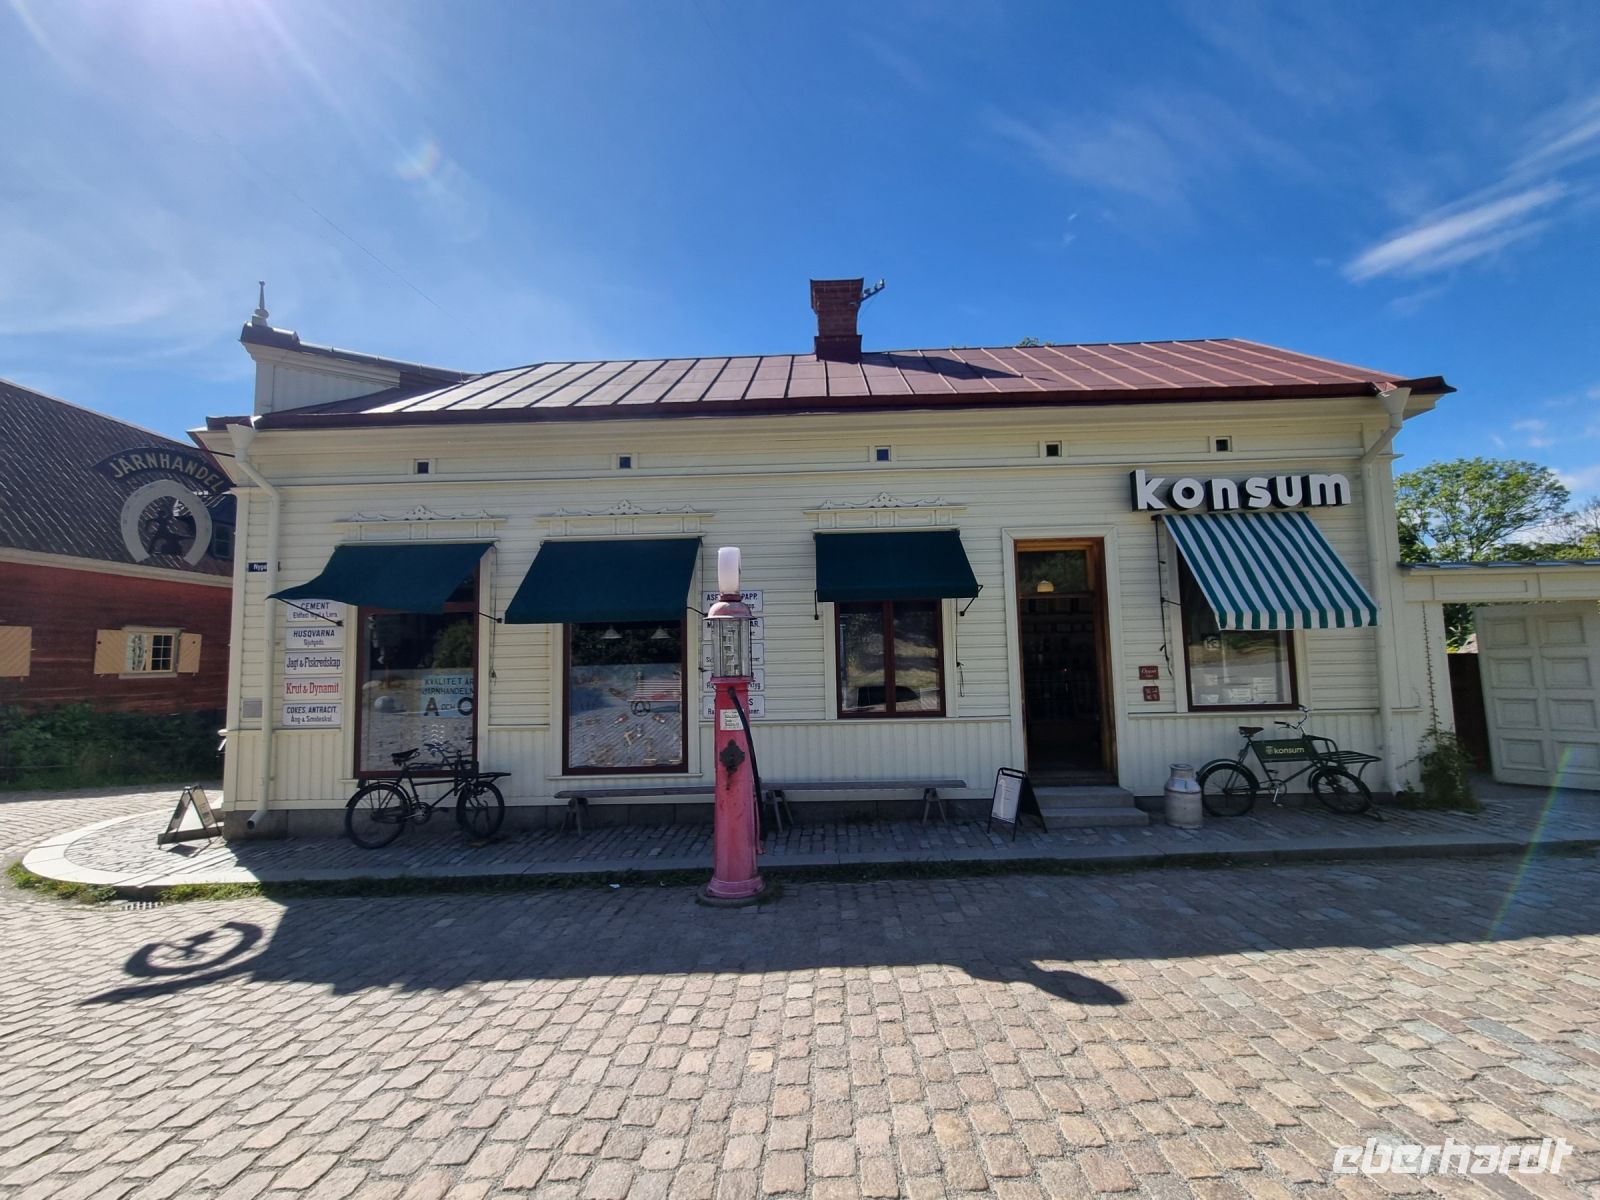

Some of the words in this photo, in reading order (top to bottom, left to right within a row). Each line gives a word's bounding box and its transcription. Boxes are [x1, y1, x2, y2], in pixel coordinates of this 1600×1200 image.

[110, 453, 224, 492] JÄRNHANDEL
[1131, 469, 1352, 511] konsum
[301, 602, 330, 610] CEMENT
[293, 629, 335, 638] HUSQVARNA
[300, 659, 305, 668] &
[305, 657, 341, 670] Fiskredskap
[424, 677, 462, 686] KVALITET
[286, 682, 302, 694] Krut
[303, 685, 308, 693] &
[309, 682, 339, 696] Dynamit
[424, 697, 440, 716] A
[1273, 747, 1305, 755] konsum
